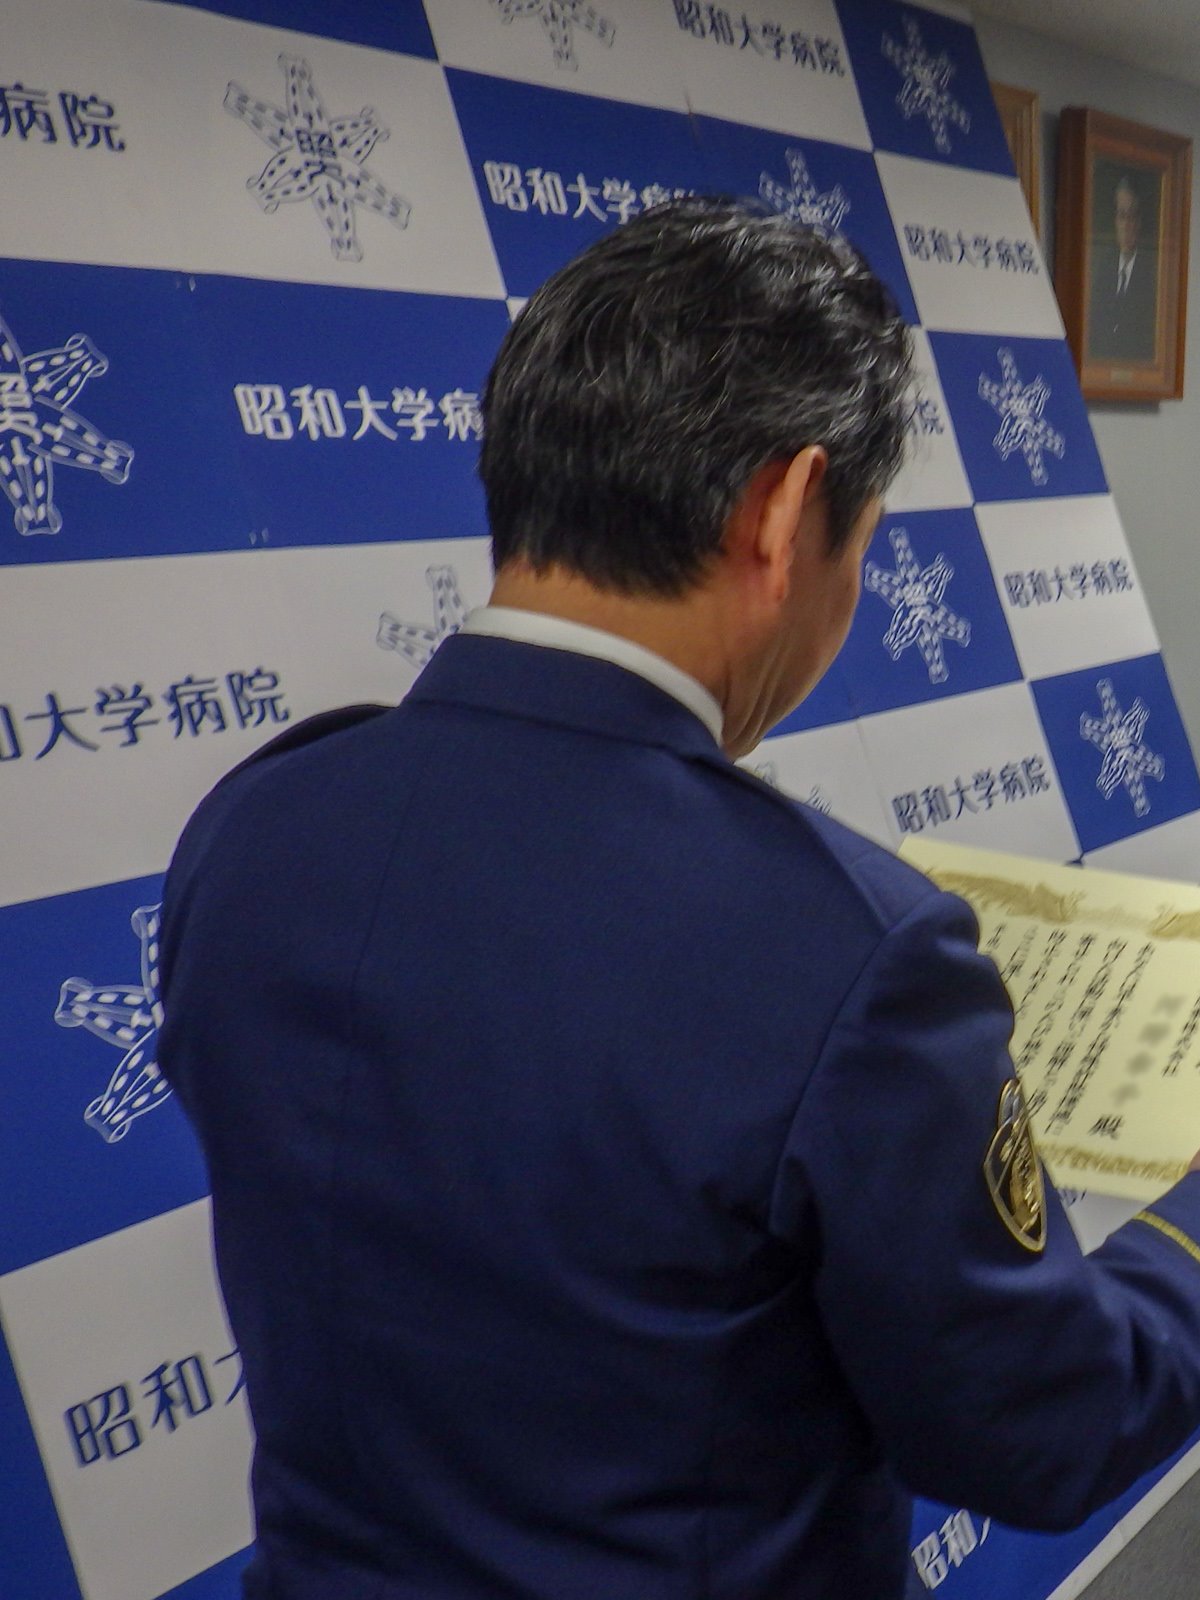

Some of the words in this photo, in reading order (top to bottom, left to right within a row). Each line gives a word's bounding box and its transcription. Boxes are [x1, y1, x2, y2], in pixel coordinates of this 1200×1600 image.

[673, 0, 846, 77] 昭和大学病院
[0, 81, 126, 152] 病院
[483, 160, 695, 225] 昭和大学
[903, 223, 1039, 275] 昭和大学病院
[1004, 559, 1134, 608] 昭和大学病院
[891, 755, 1052, 834] 昭和大学病院
